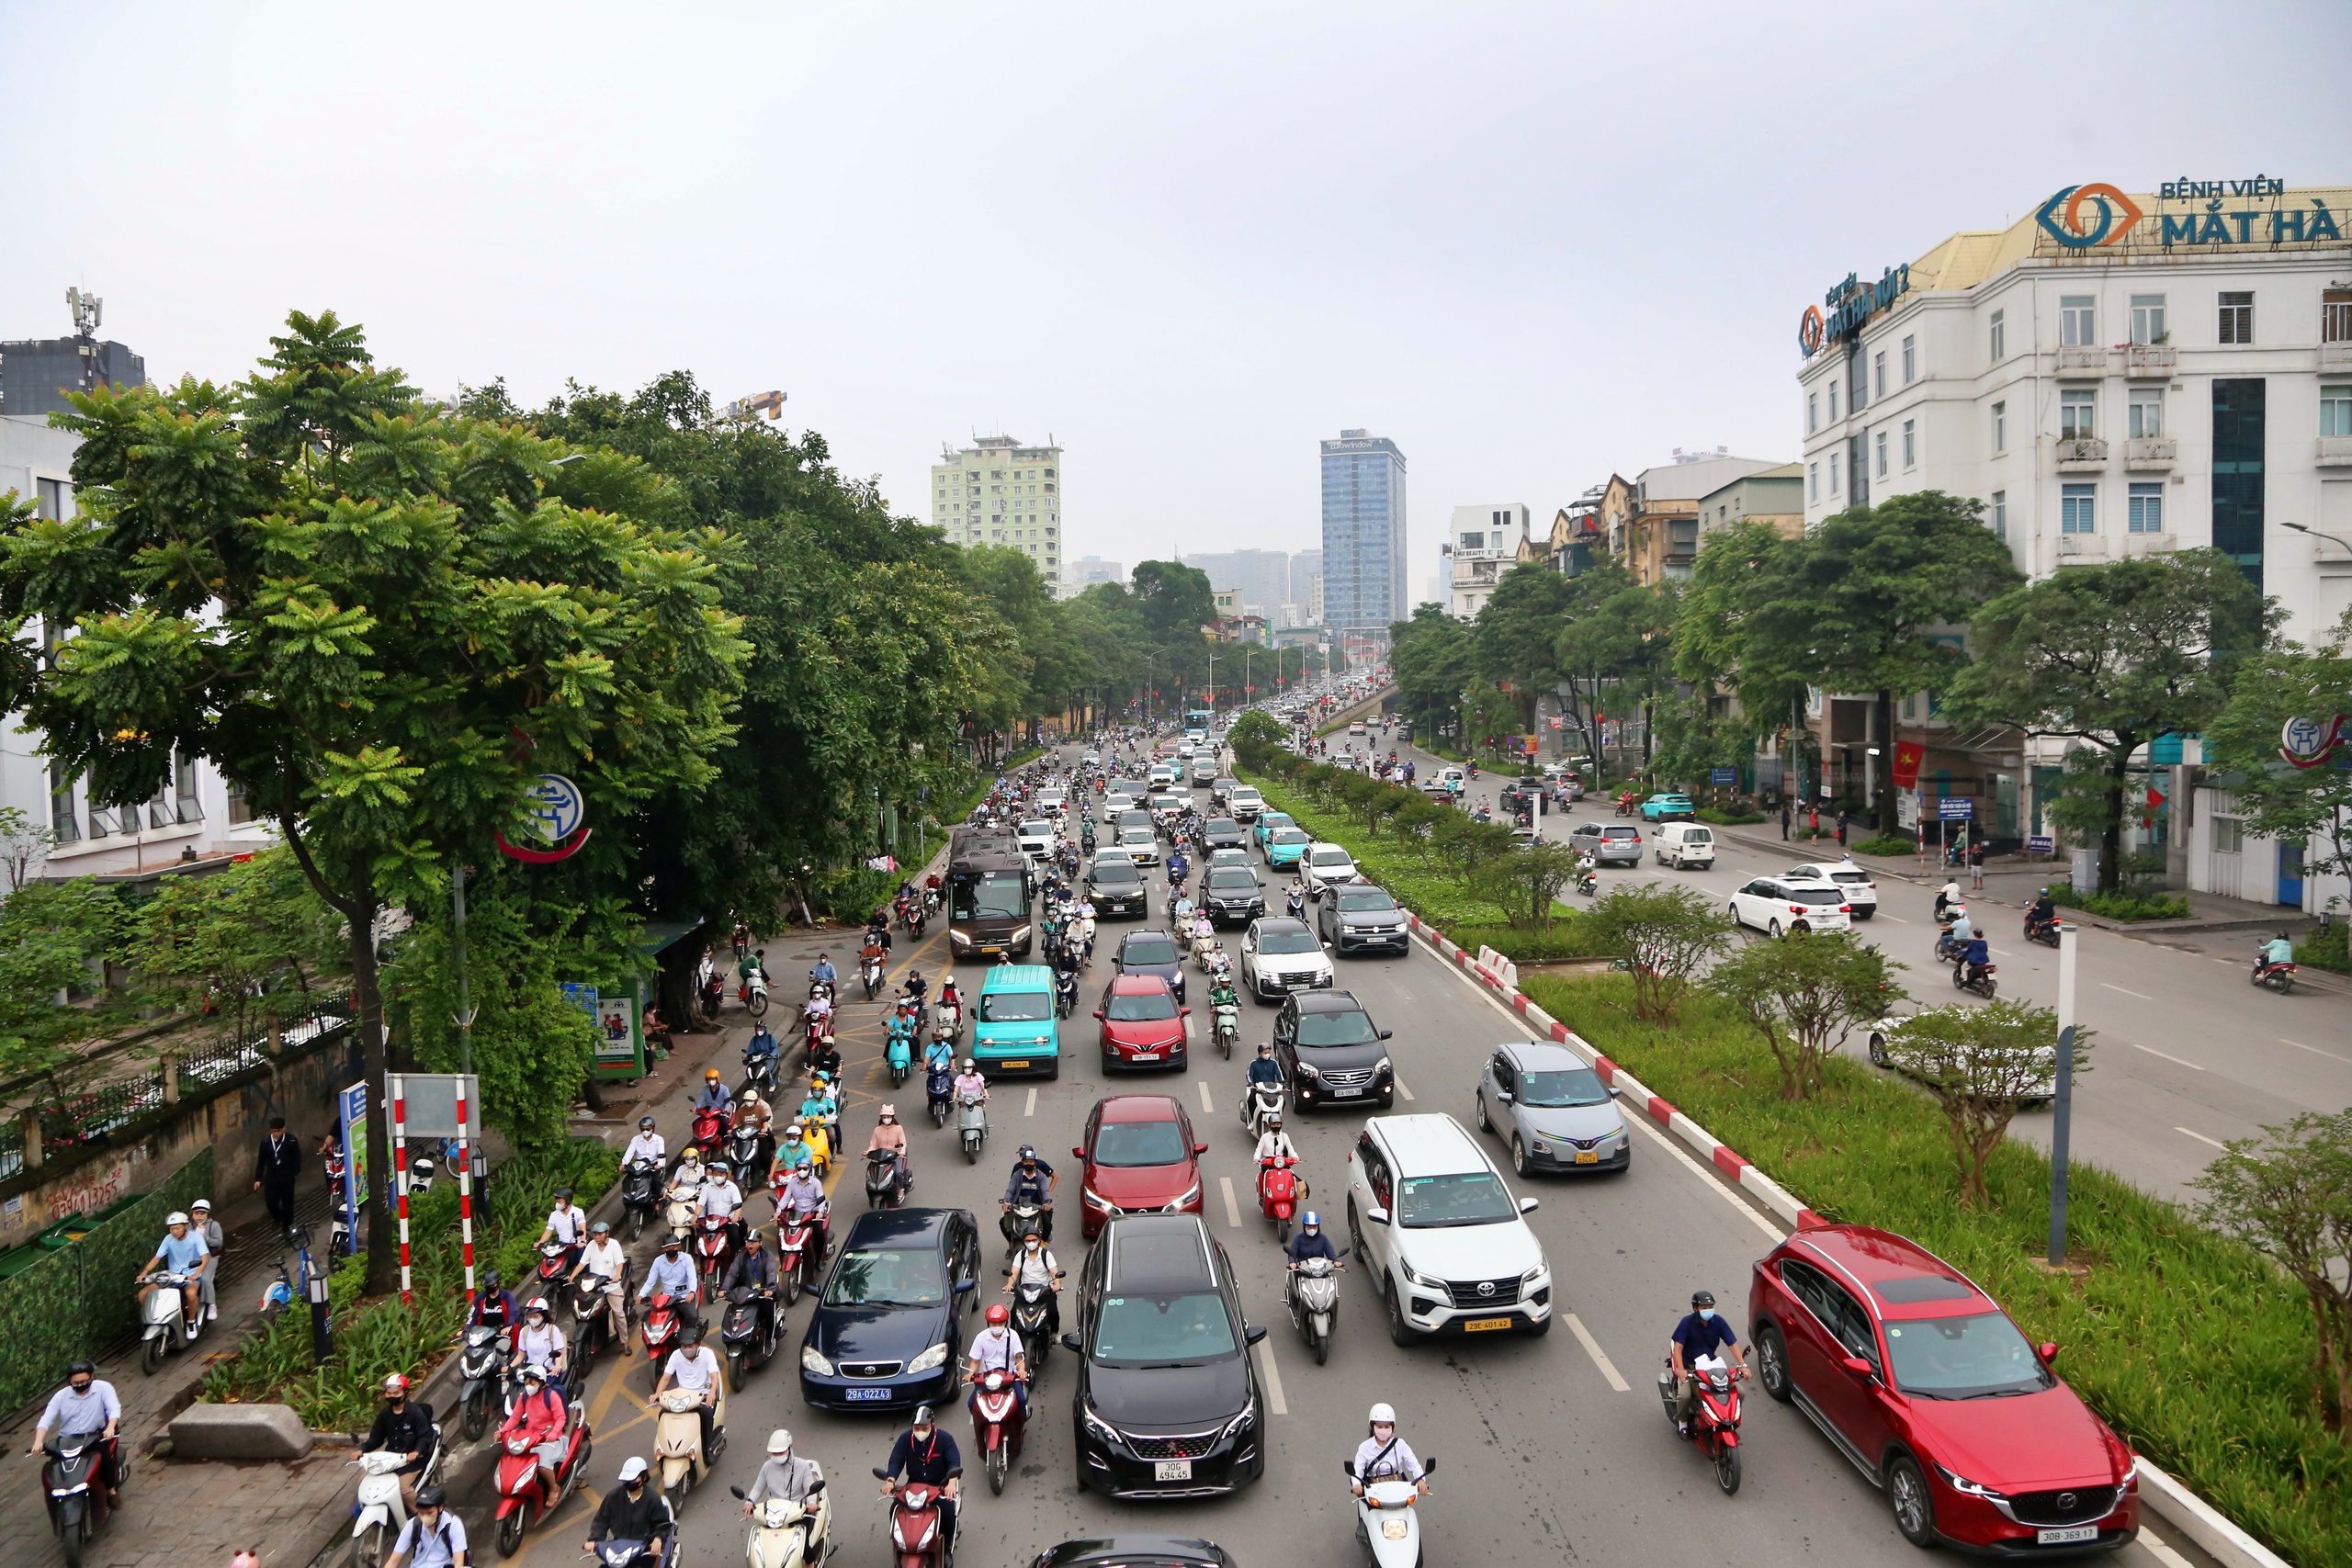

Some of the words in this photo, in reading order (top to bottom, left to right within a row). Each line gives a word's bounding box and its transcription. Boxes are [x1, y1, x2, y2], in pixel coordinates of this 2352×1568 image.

[2160, 175, 2224, 205] BỆNH
[2229, 173, 2284, 202] VIỆN
[2161, 198, 2260, 245] MẮT
[2272, 197, 2342, 243] HÀ
[1872, 266, 1898, 312] NỘI
[1900, 263, 1909, 293] 2
[1159, 1470, 1188, 1480] 494.45
[1165, 1462, 1182, 1471] 30G
[2043, 1529, 2093, 1541] 30B-369.17
